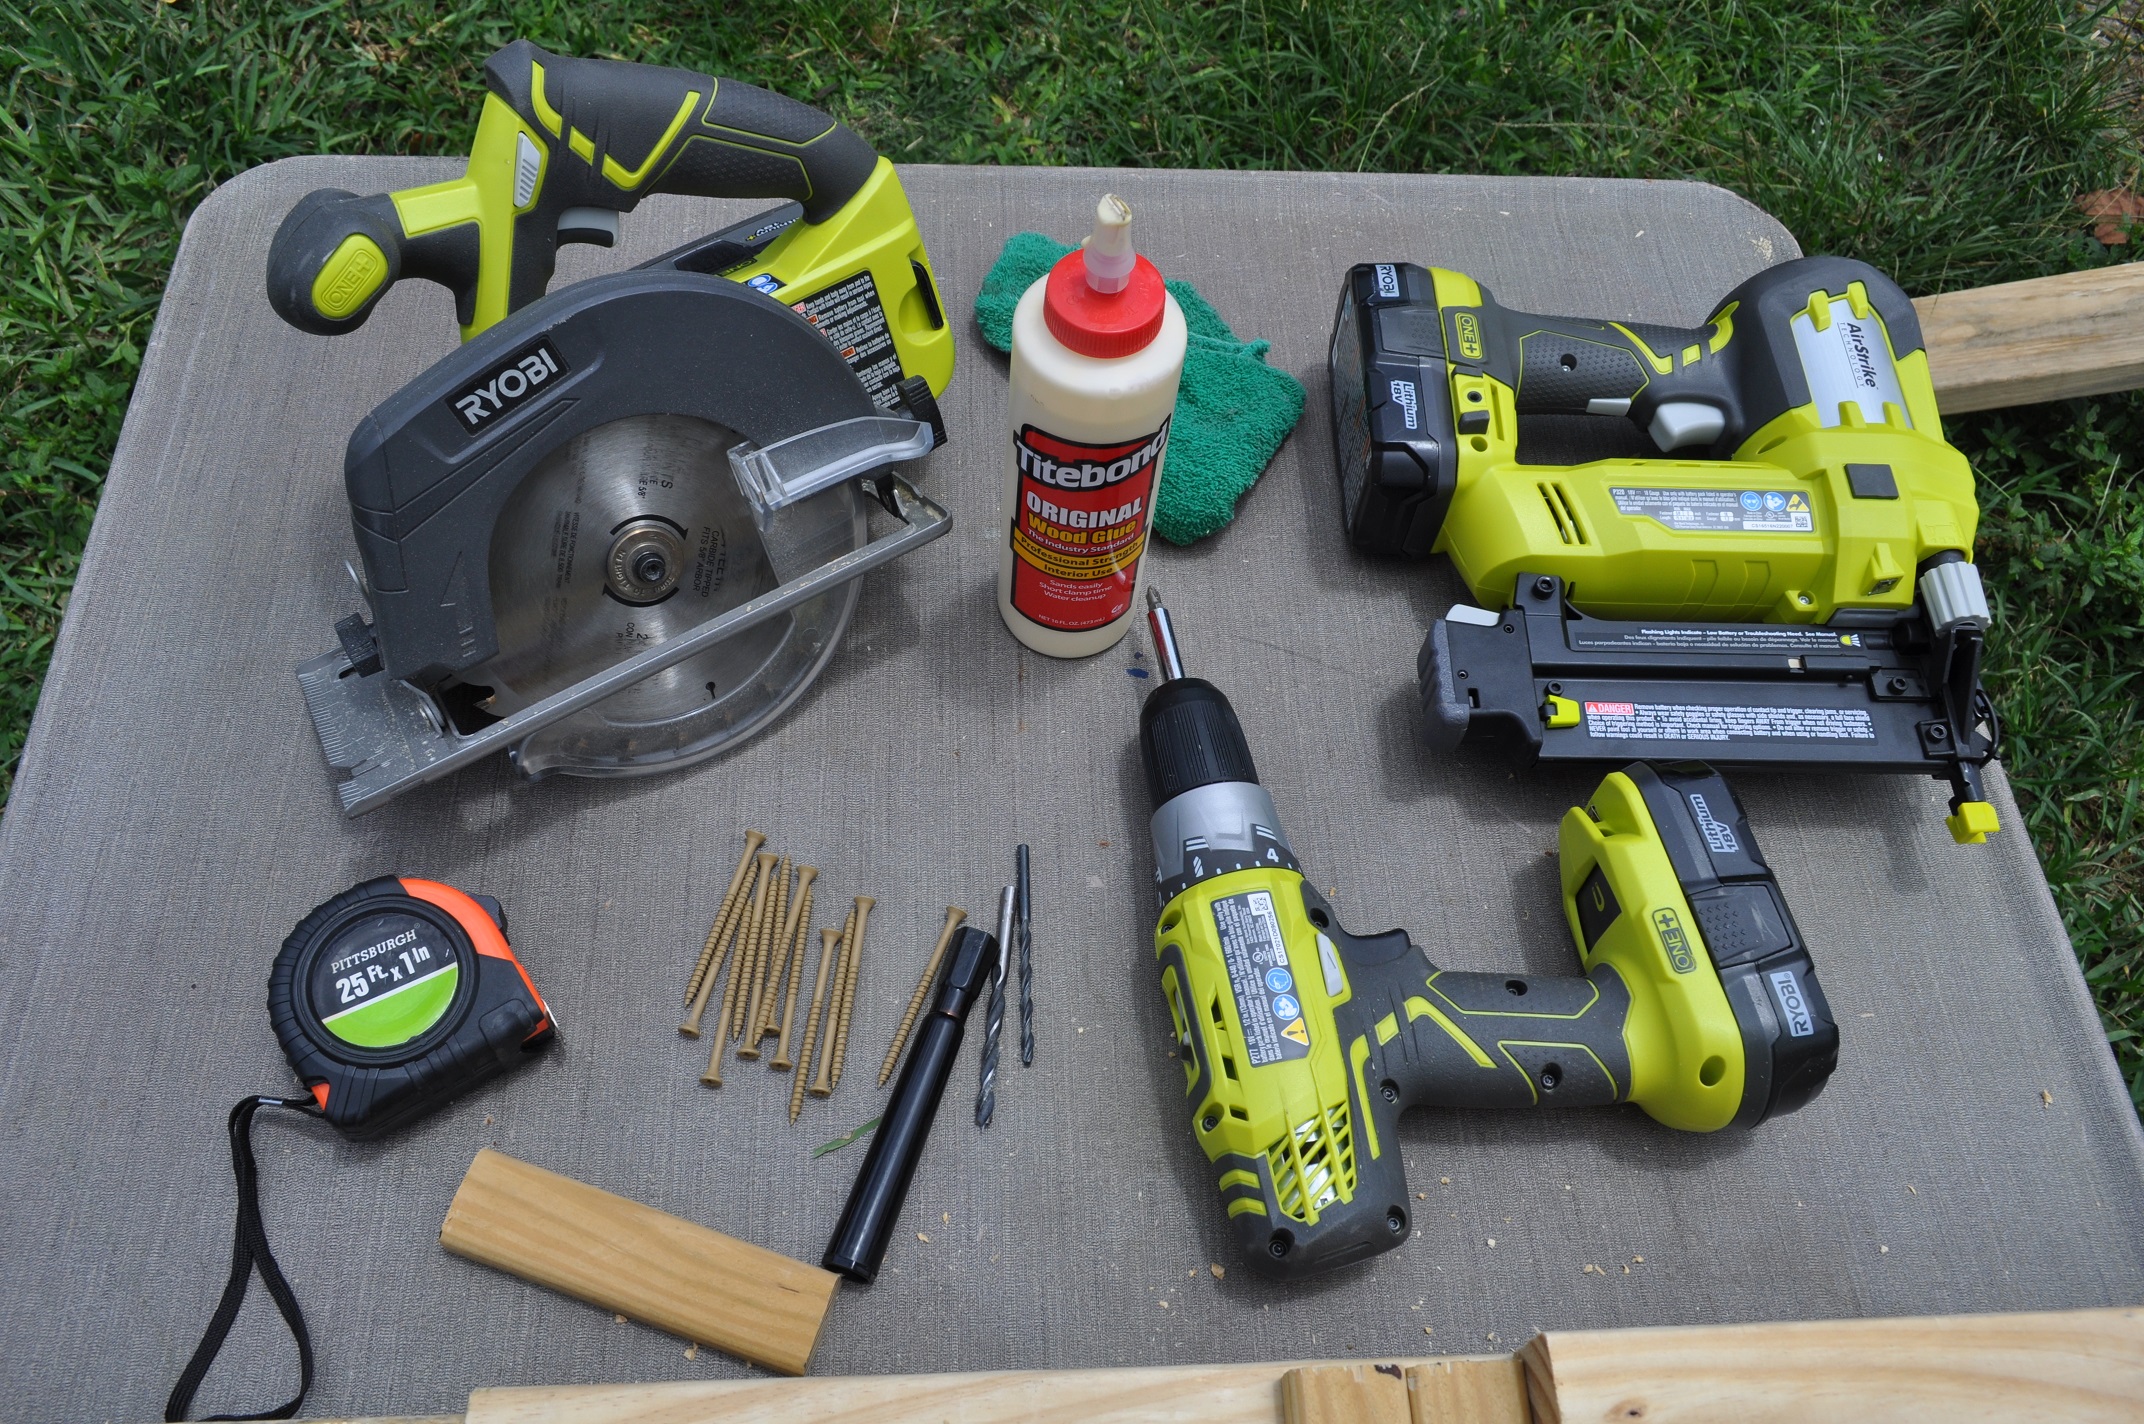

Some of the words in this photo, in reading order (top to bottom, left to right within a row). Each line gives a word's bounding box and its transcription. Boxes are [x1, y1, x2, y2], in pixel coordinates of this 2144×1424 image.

[1381, 265, 1396, 294] RYOBI
[1461, 315, 1478, 355] ONE+
[1840, 322, 1865, 387] TECHNOLOGY
[1847, 322, 1877, 388] AirStrike
[455, 348, 558, 425] RYOBI
[1392, 381, 1403, 404] 18V
[1404, 382, 1417, 429] Lithium
[1017, 421, 1168, 488] Titebond
[1026, 490, 1143, 528] ORIGINAL
[700, 526, 710, 545] FITS
[1028, 512, 1087, 544] Wood
[1091, 519, 1137, 544] Glue
[1028, 528, 1044, 542] The
[1046, 539, 1088, 554] Industry
[1090, 533, 1135, 552] Standard
[707, 530, 719, 567] CARBIDE
[1021, 537, 1089, 566] Professional
[1093, 542, 1138, 564] Strength
[692, 562, 703, 592] ARBOR
[701, 569, 713, 598] TIPPED
[1044, 564, 1089, 577] Interior
[1092, 567, 1112, 577] Use
[1050, 580, 1077, 589] Sands
[1039, 582, 1063, 594] Short
[1093, 585, 1113, 594] time
[1043, 590, 1071, 601] Water
[1597, 703, 1631, 713] DANGER
[1693, 796, 1725, 851] Lithium
[1717, 823, 1738, 852] 18V
[1266, 848, 1279, 863] 4
[1213, 901, 1222, 911] with
[1215, 911, 1225, 920] only
[1218, 921, 1226, 930] Use
[331, 929, 417, 974] PITTSBURGH
[1660, 913, 1692, 969] ONE+
[336, 972, 369, 1004] 25
[367, 965, 389, 983] Ft.
[390, 967, 403, 982] x
[399, 952, 415, 977] 1
[412, 945, 431, 964] In
[1233, 982, 1242, 993] VSR
[1778, 979, 1809, 1034] RYOBI
[1249, 1048, 1260, 1064] P277
